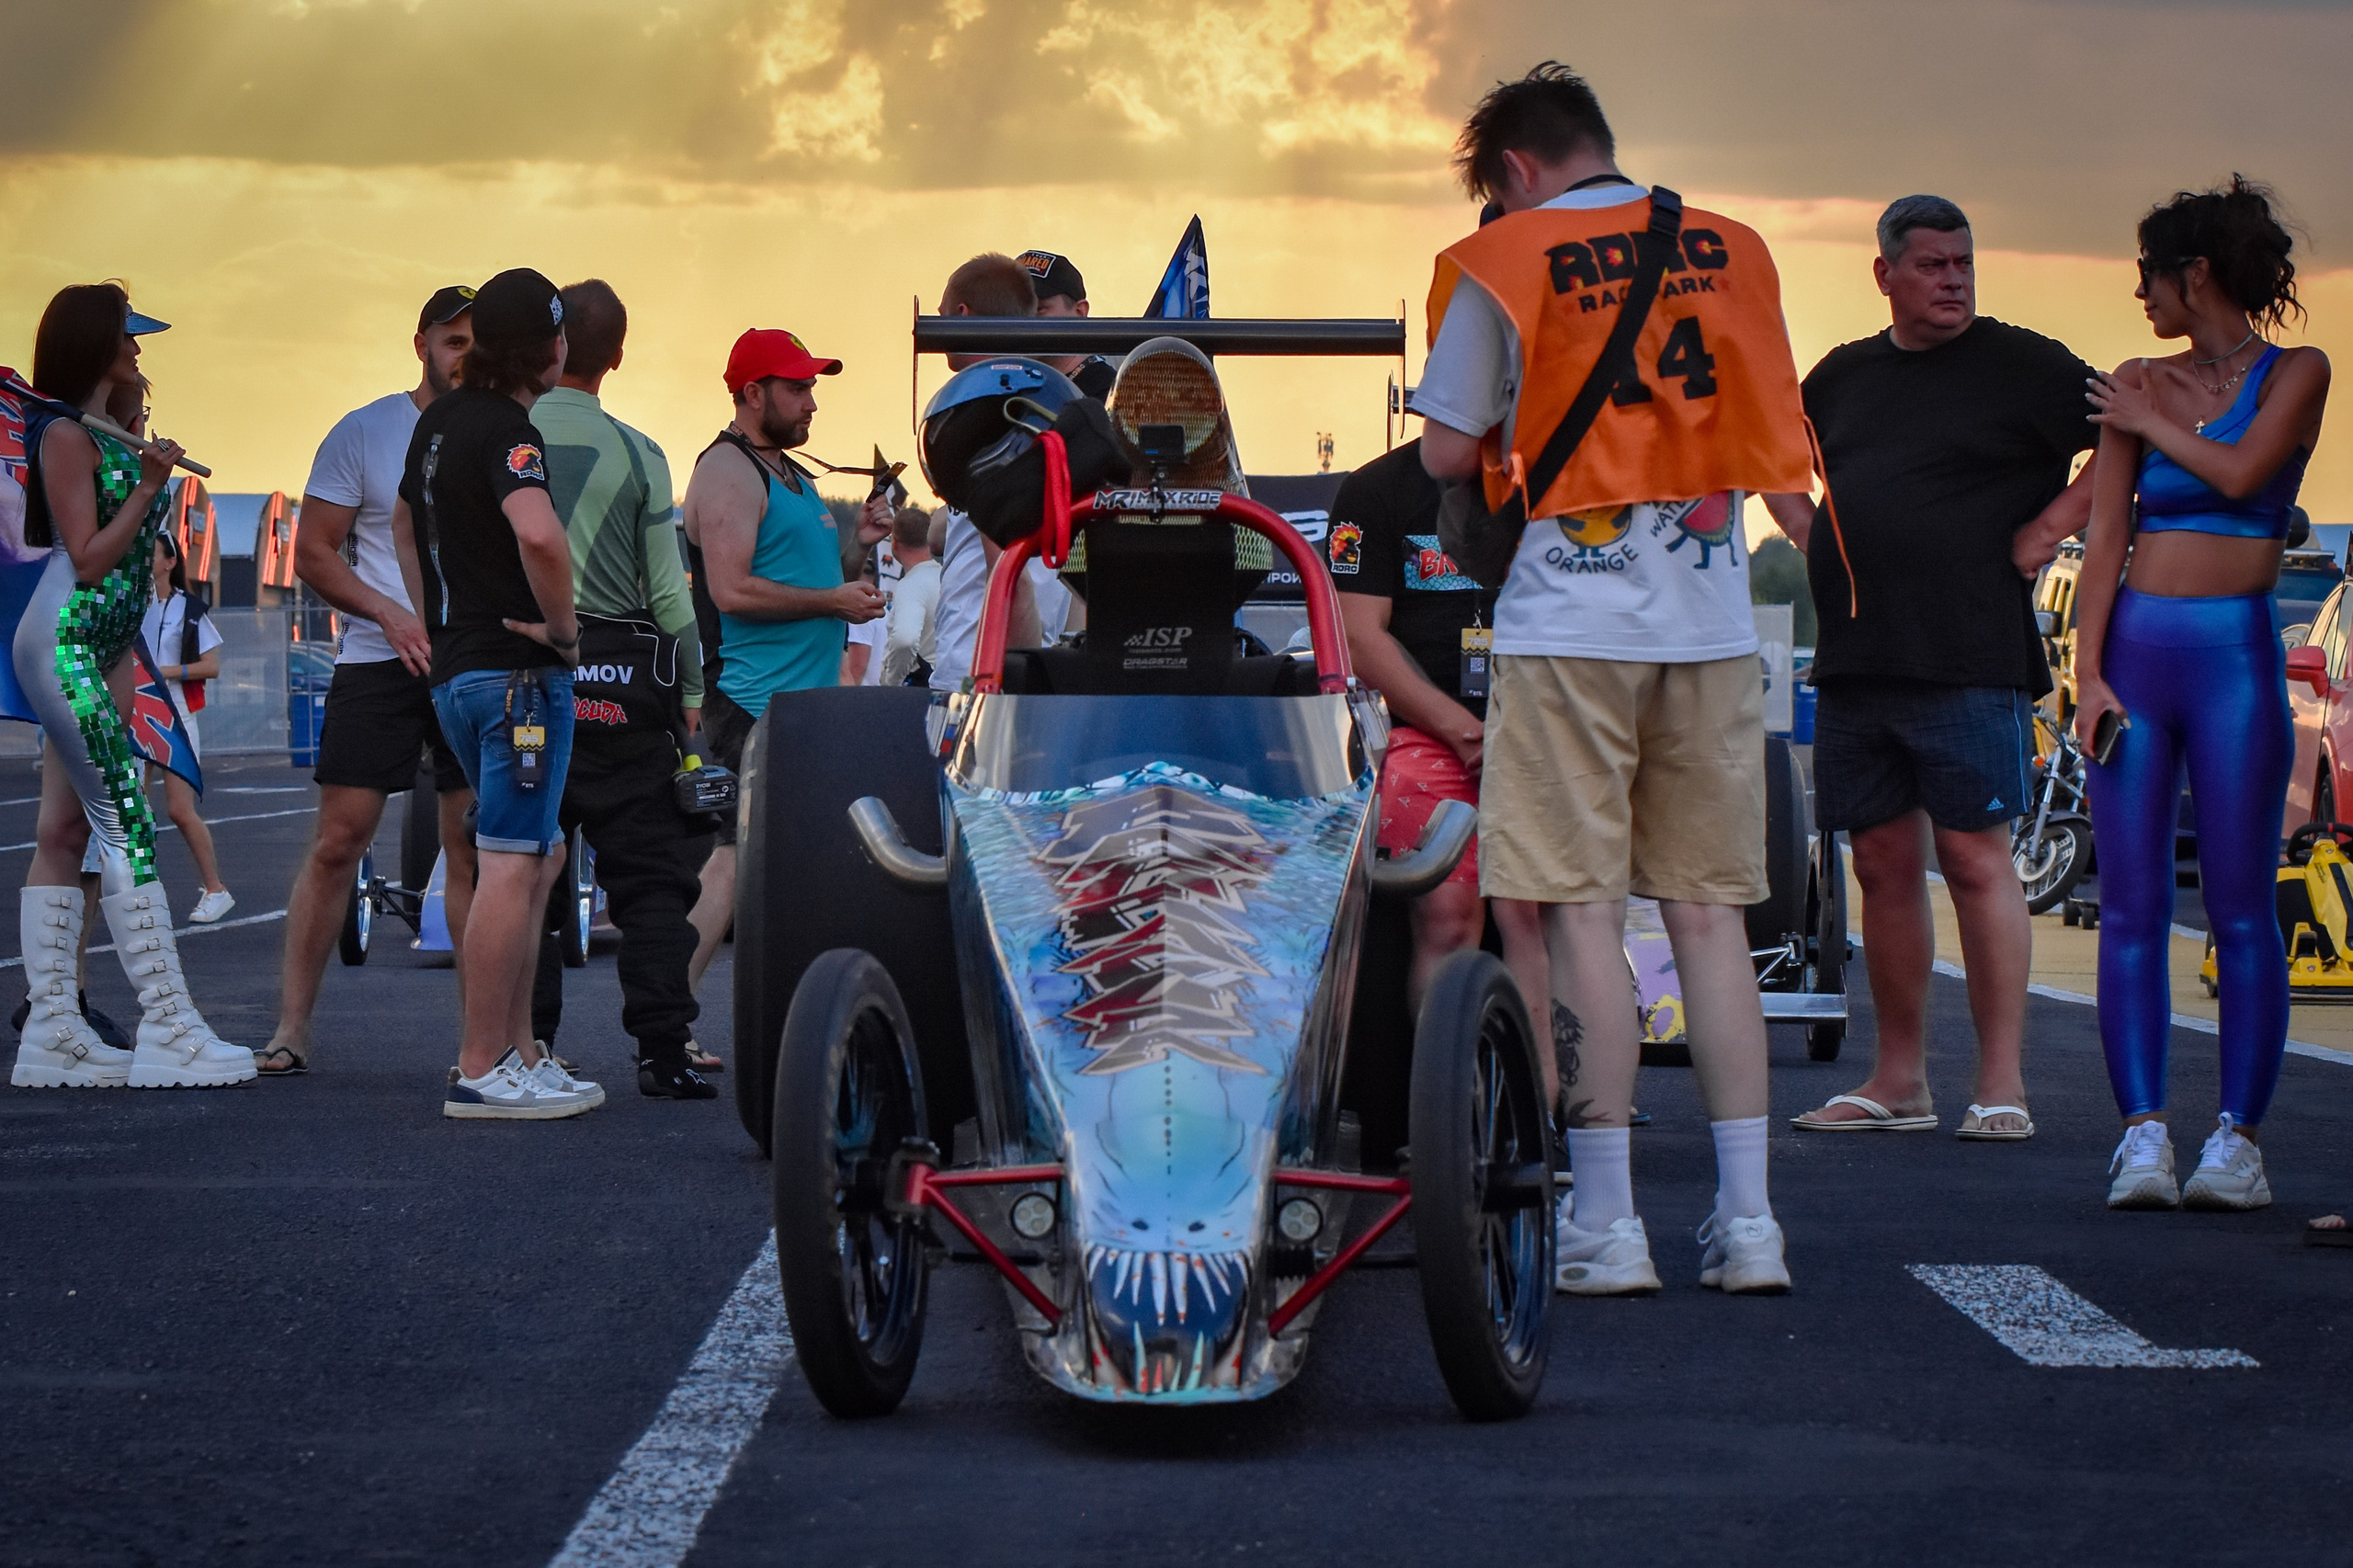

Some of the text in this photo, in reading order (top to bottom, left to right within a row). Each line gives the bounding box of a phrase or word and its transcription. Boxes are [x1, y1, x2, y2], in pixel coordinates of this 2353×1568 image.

[1663, 276, 1716, 299] ARK
[1137, 491, 1222, 505] MXRIDE
[1333, 564, 1358, 573] RDRC
[1418, 548, 1464, 582] BA
[1545, 543, 1639, 574] ORANGE
[1142, 627, 1193, 647] ISP
[1123, 657, 1188, 665] DRAGSTAR
[574, 665, 633, 685] MOV
